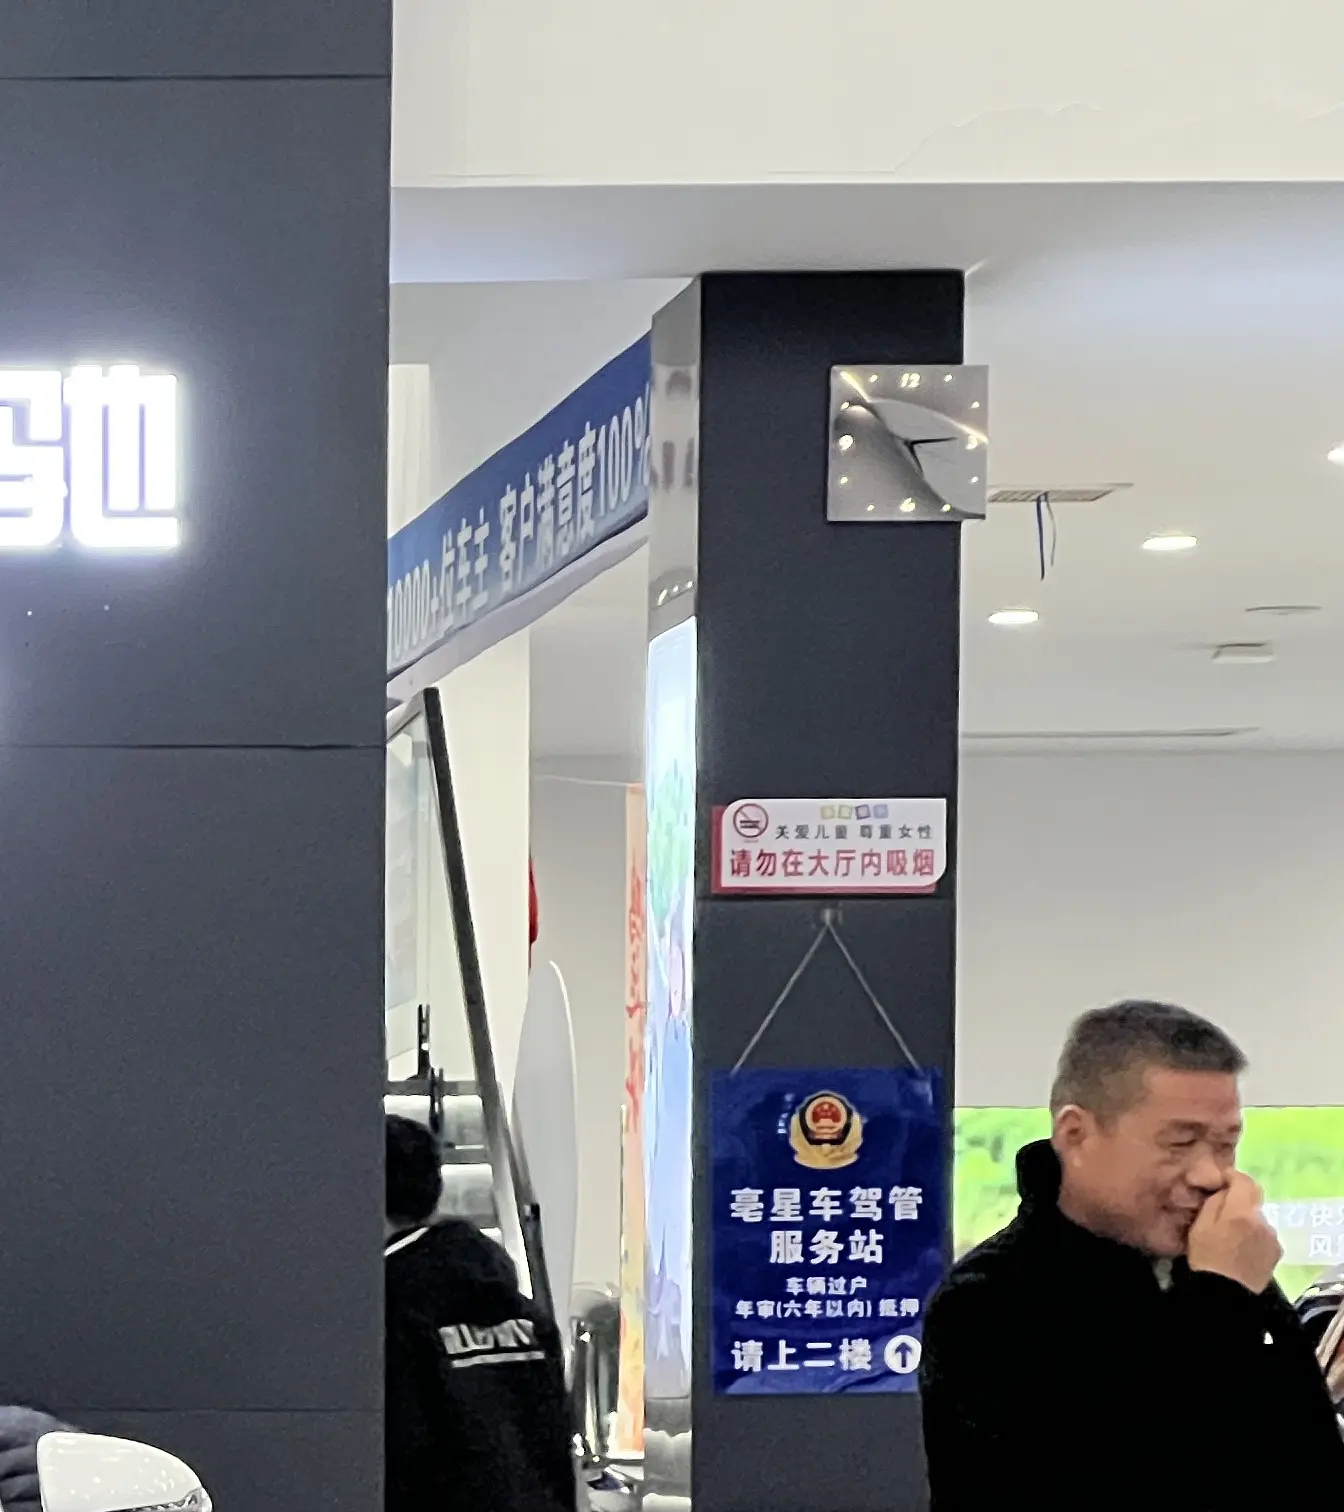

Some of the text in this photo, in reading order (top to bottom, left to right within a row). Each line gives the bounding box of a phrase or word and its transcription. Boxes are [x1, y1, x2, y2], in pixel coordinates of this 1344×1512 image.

[774, 824, 849, 840] 关爱儿童
[730, 848, 936, 878] 请勿在大厅内吸烟
[768, 1228, 885, 1264] 服务站
[785, 1276, 868, 1296] 车辆过户
[730, 1339, 872, 1372] 请上二楼
